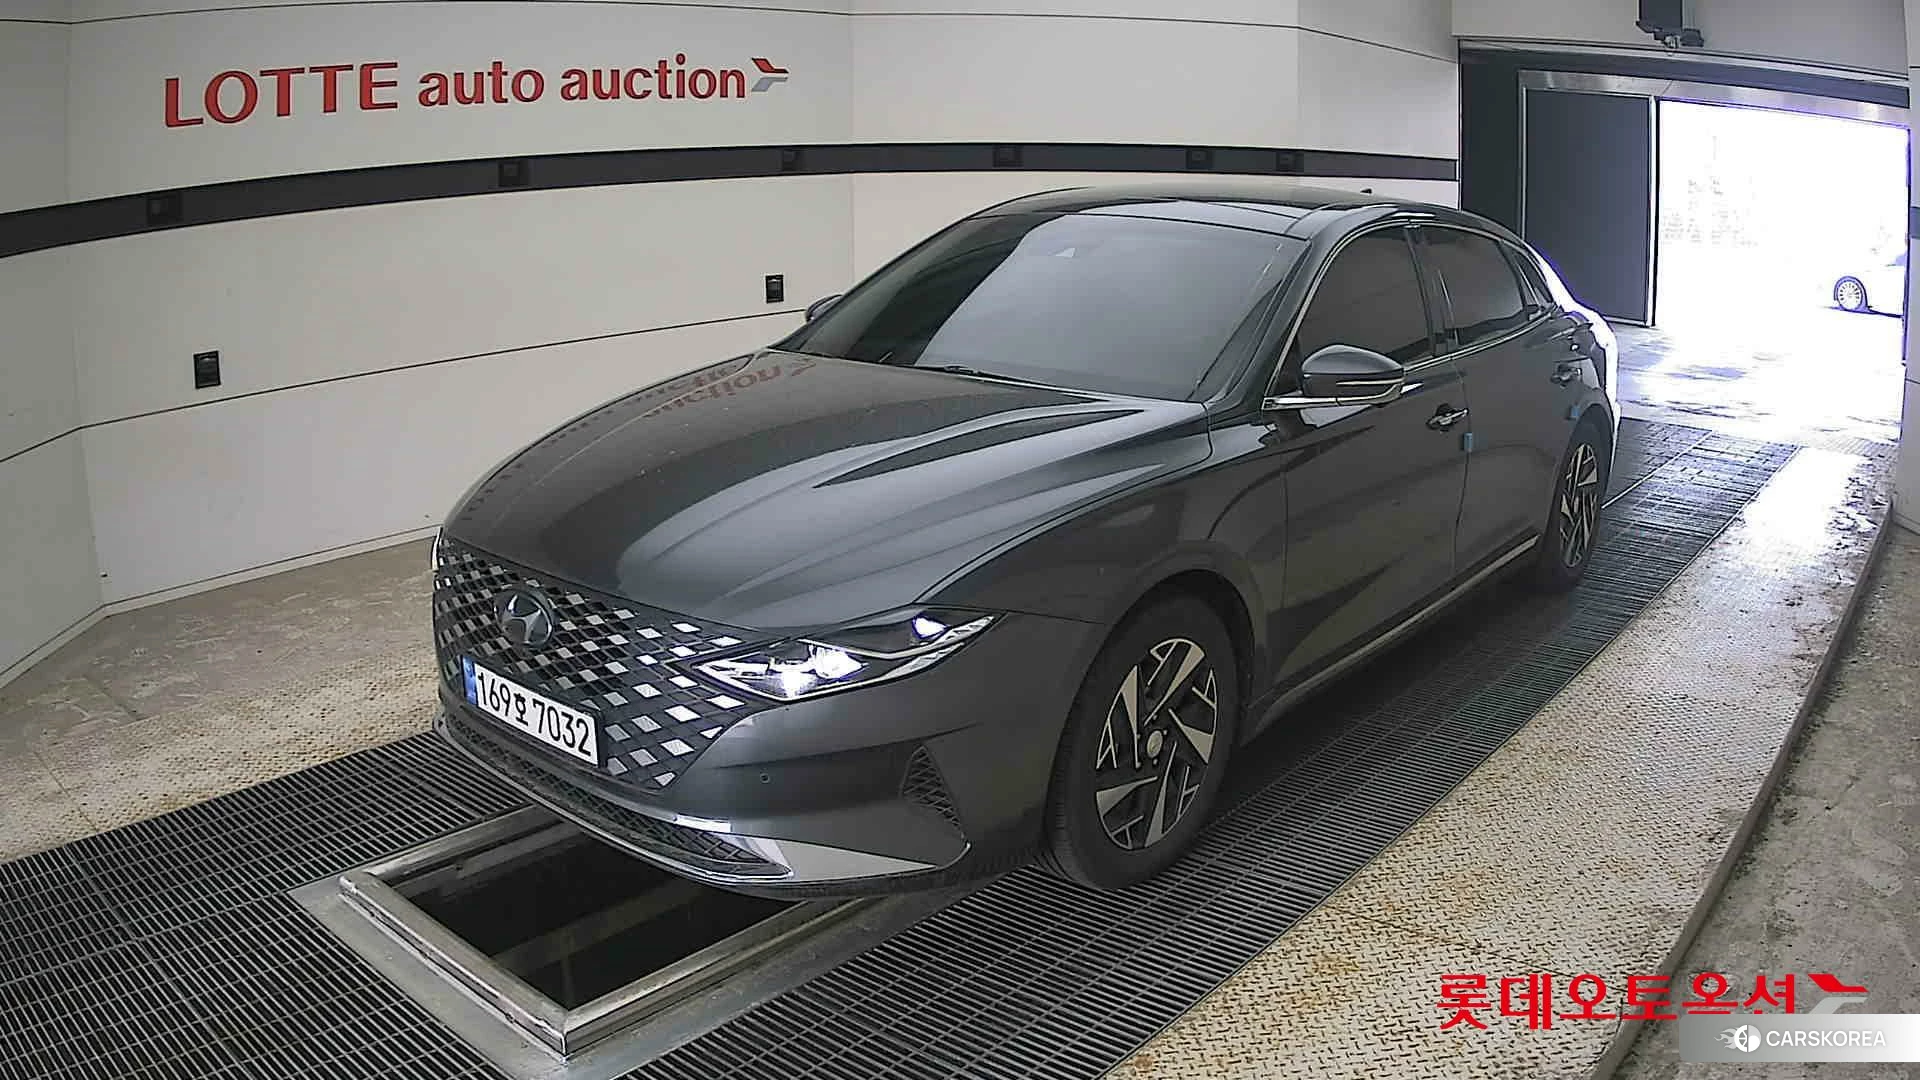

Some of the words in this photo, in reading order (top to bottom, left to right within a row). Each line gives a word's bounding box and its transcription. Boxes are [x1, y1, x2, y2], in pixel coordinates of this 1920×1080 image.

[164, 62, 399, 128] LOTTE
[418, 61, 545, 107] auto
[560, 53, 746, 101] auction
[477, 671, 529, 727] 169호
[532, 698, 592, 757] 7032
